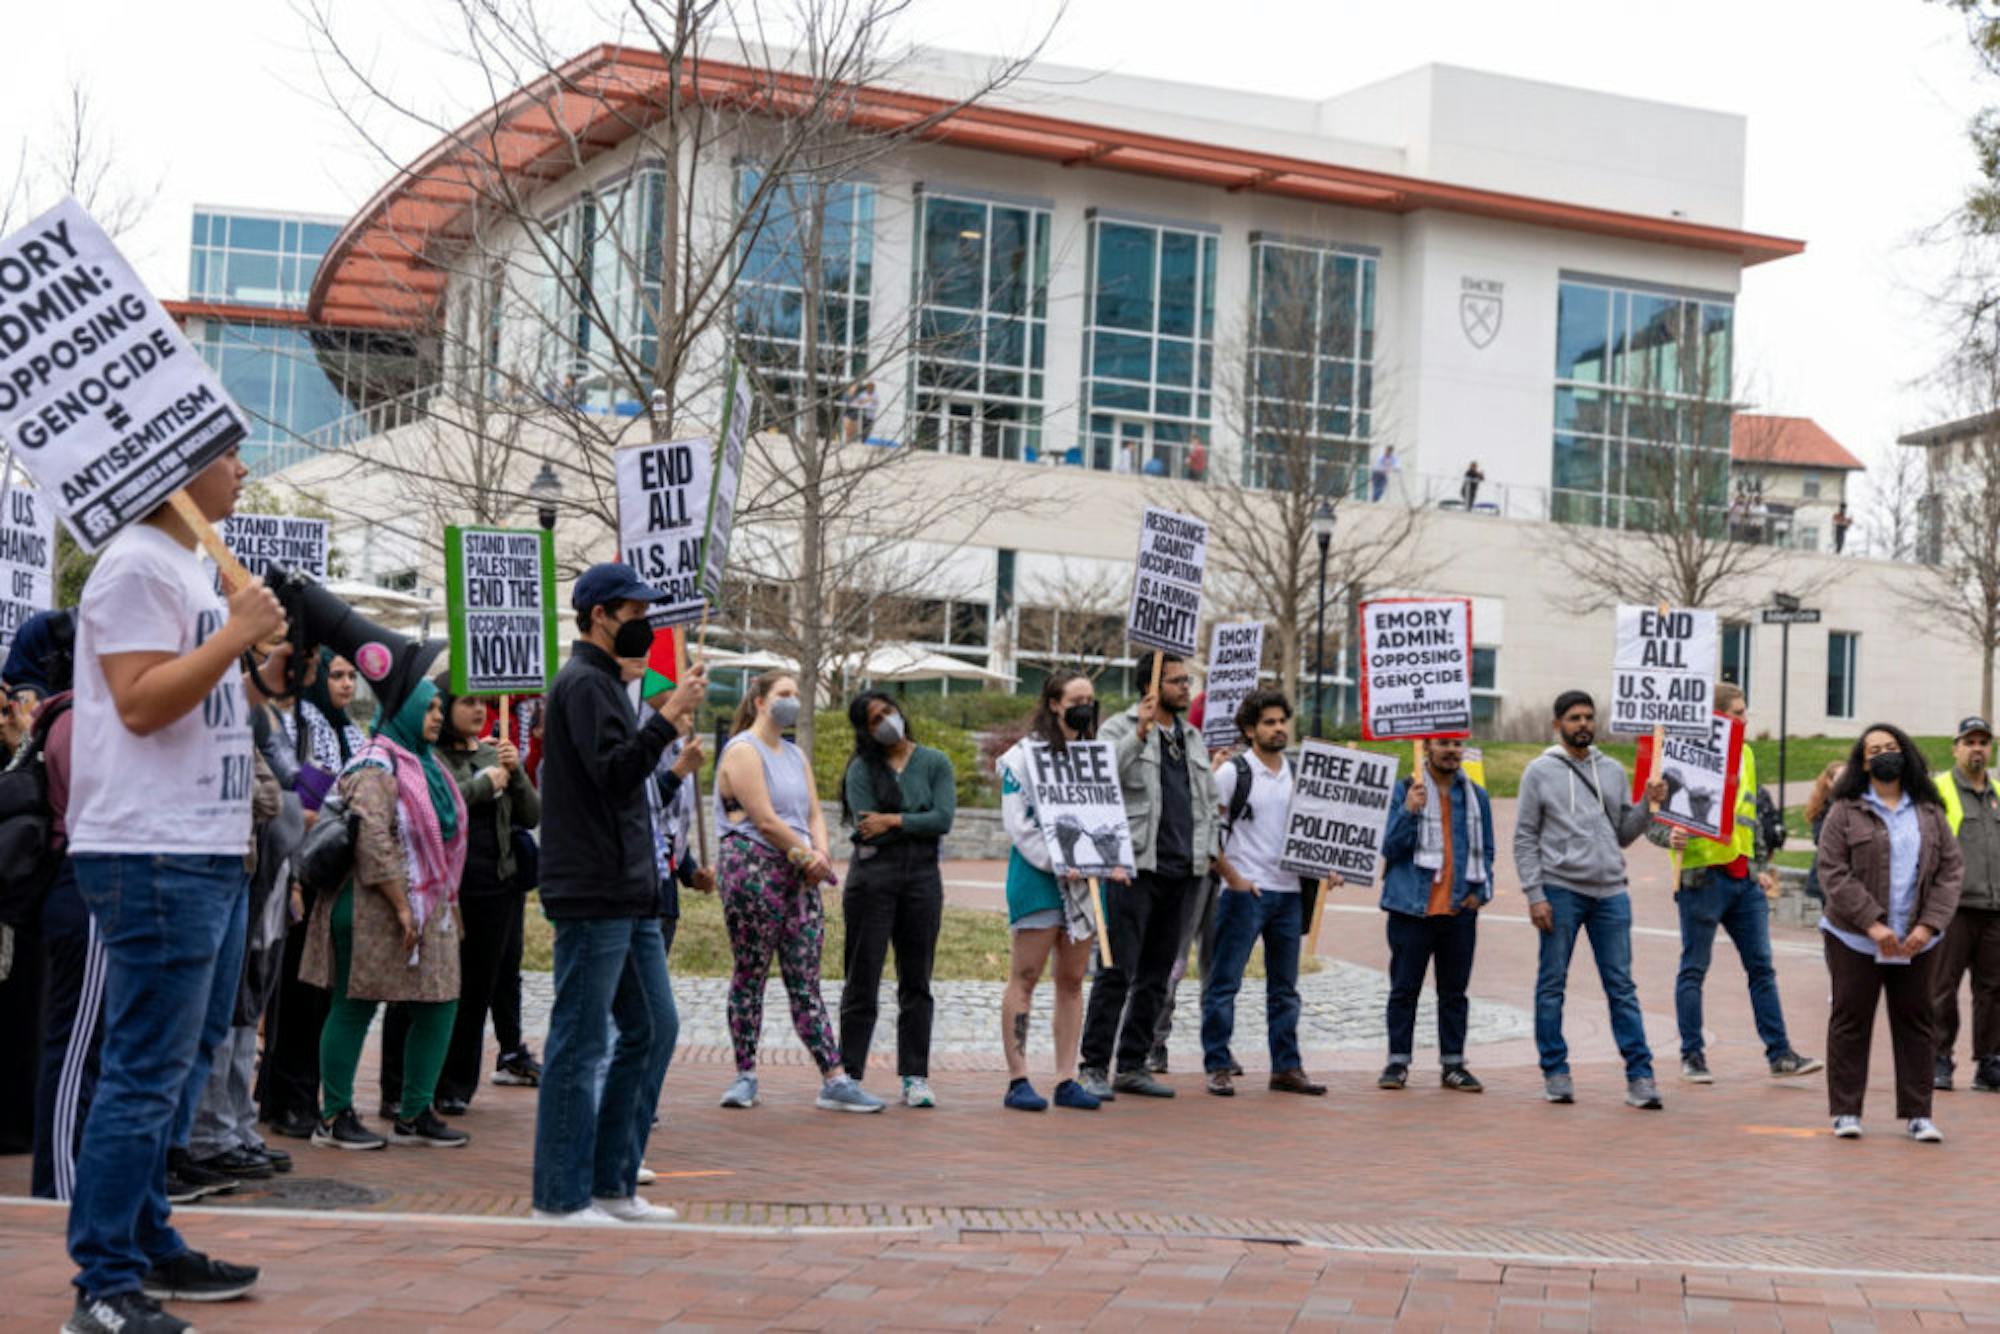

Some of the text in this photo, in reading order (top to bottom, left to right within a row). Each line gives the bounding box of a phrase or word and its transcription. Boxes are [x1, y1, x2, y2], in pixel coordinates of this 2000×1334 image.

[0, 219, 78, 294] ORY
[0, 264, 113, 357] DMIN:
[0, 293, 147, 412] OPPOSING
[17, 329, 177, 449] GENOCIDE
[60, 384, 216, 506] ANTISEMITISM
[640, 446, 693, 491] END
[648, 488, 692, 532] ALL
[224, 516, 323, 540] STAND WITH
[1146, 511, 1206, 545] RESISTANCE
[224, 535, 322, 561] PALESTINE!
[465, 534, 537, 555] STAND WITH
[1152, 534, 1195, 561] AGAINST
[467, 556, 538, 578] PALESTINE!
[628, 543, 672, 579] U.S.
[1140, 551, 1203, 584] OCCUPATION
[12, 569, 34, 600] OFF
[468, 579, 539, 608] END THE
[1140, 576, 1200, 611] IS A HUMAN
[469, 615, 540, 633] OCCUPATION
[1134, 597, 1196, 644] RIGHT!
[1375, 609, 1452, 630] EMORY
[1640, 610, 1693, 640] END
[1219, 628, 1258, 646] EMORY
[1377, 628, 1454, 649] ADMIN:
[471, 635, 540, 675] NOW!
[1371, 649, 1462, 668] OPPOSING
[1641, 640, 1687, 668] ALL
[1373, 669, 1463, 689] GENOCIDE
[1619, 675, 1706, 702] U.S. AID
[1375, 699, 1465, 717] ANTISEMITISM
[1616, 700, 1706, 724] TO ISRAEL!
[1032, 744, 1112, 784] FREE
[1301, 751, 1389, 789] FREE ALL
[1663, 740, 1724, 774] ALESTINE
[1036, 783, 1120, 805] PALESTINE
[1296, 777, 1389, 811] PALESTINIAN
[1290, 813, 1378, 850] POLITICAL
[1284, 838, 1376, 873] PRISONERS
